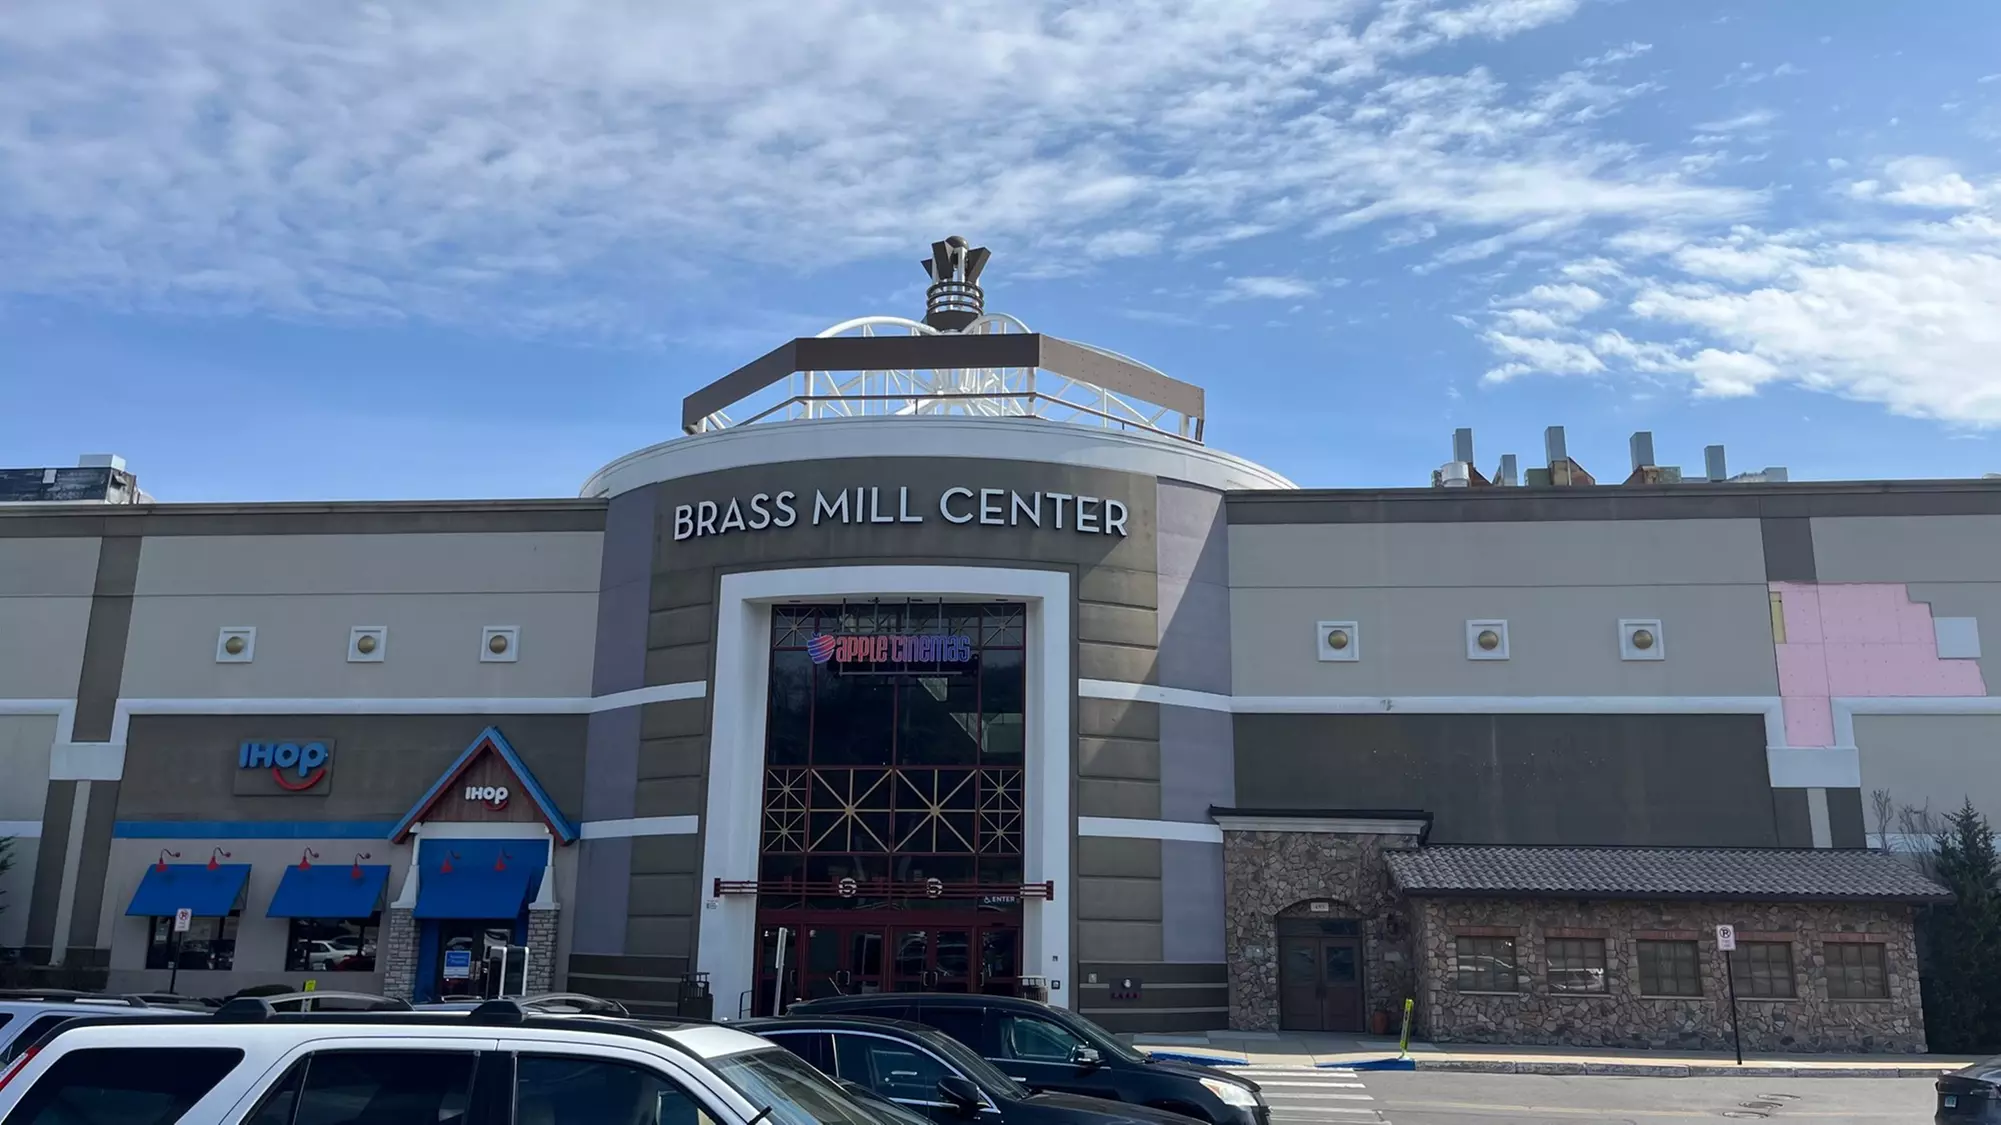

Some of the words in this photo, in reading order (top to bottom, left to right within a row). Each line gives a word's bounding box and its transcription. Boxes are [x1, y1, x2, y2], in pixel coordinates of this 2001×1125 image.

[673, 490, 797, 542] BRASS
[812, 486, 923, 525] MILL
[939, 486, 1129, 538] CENTER
[836, 634, 888, 663] apple
[890, 634, 971, 663] cinemas
